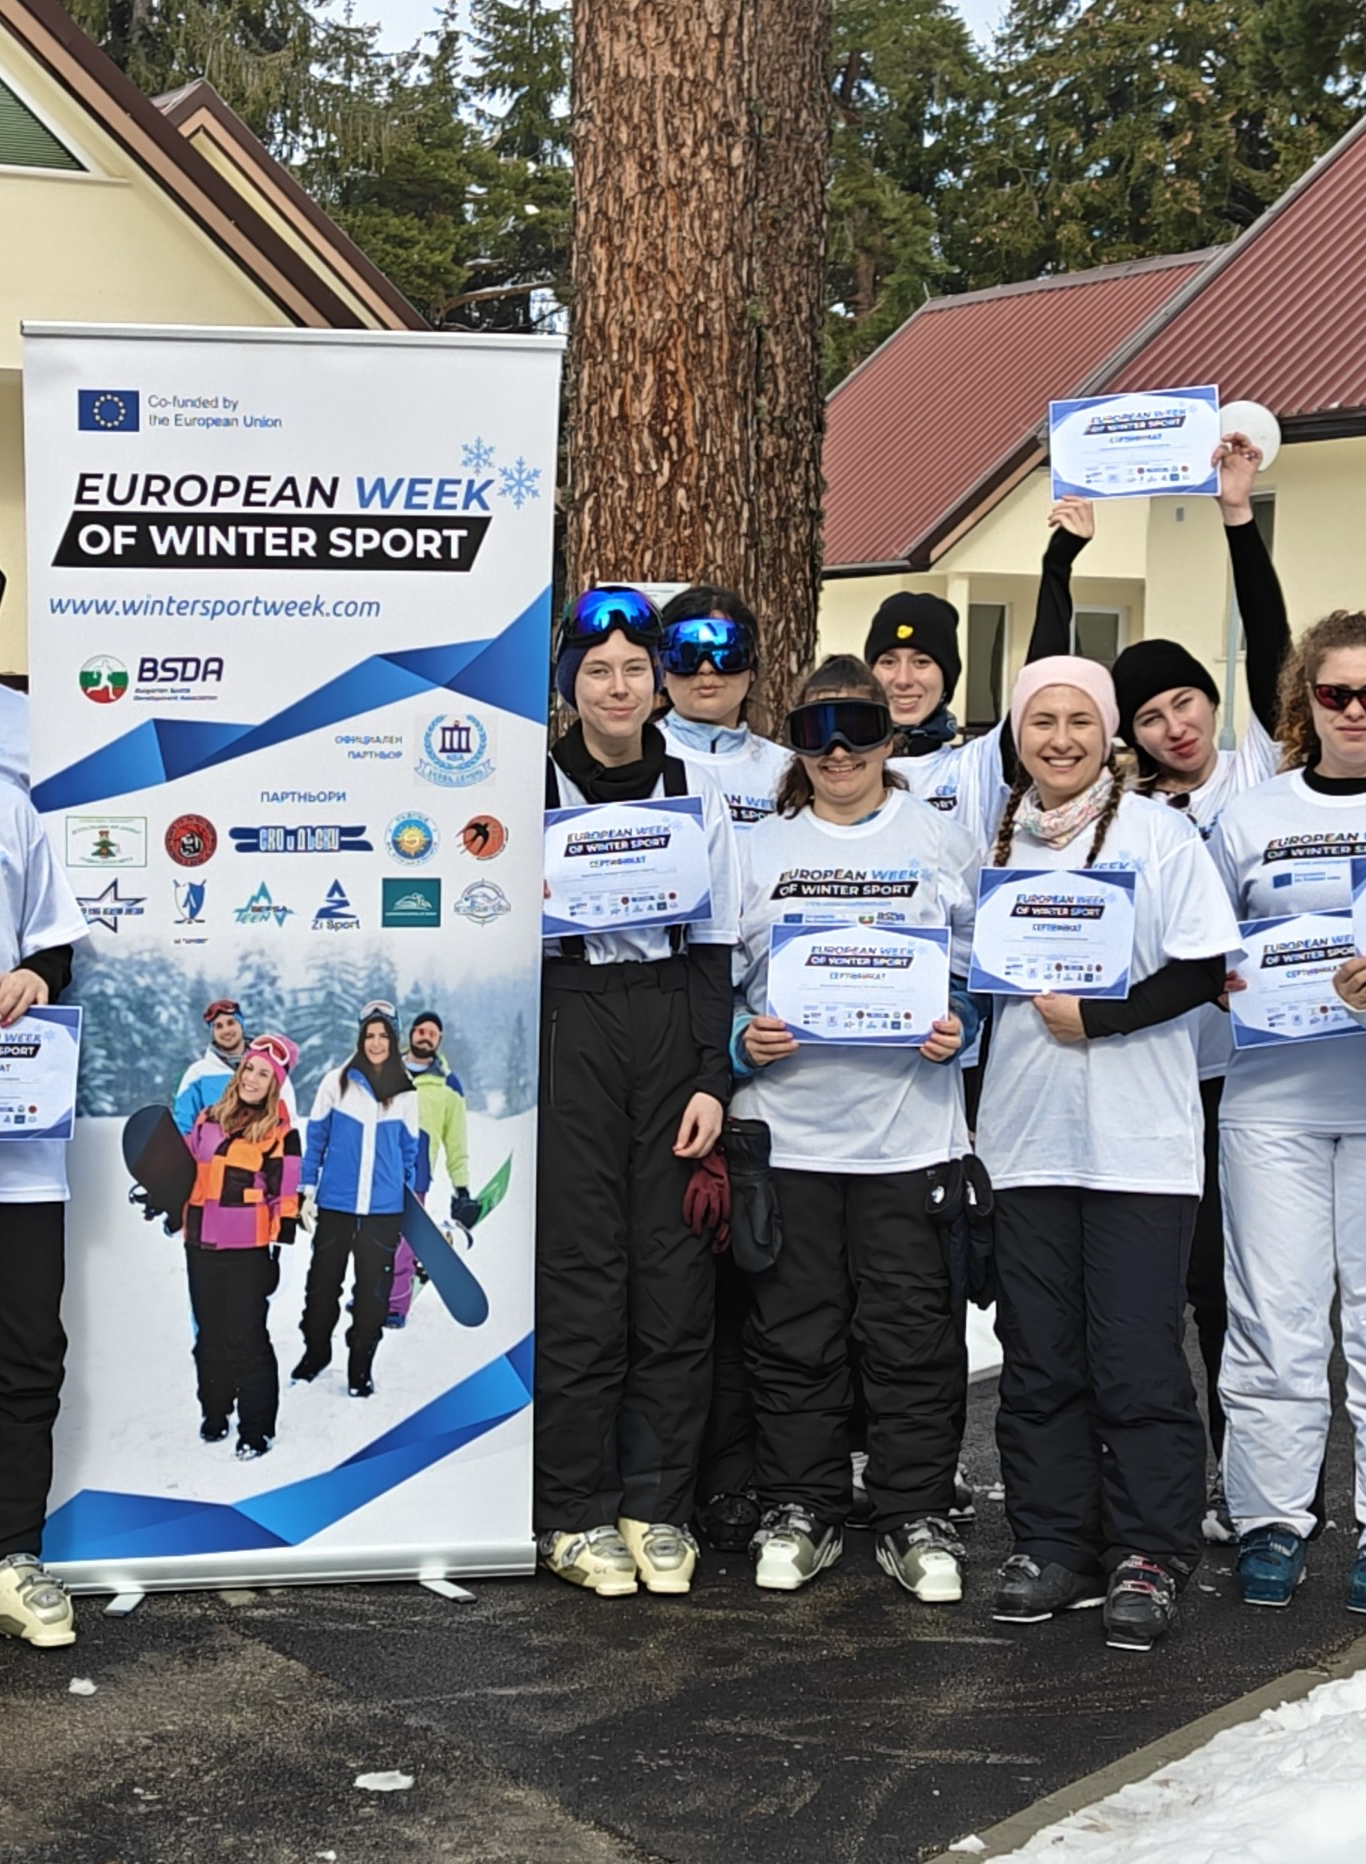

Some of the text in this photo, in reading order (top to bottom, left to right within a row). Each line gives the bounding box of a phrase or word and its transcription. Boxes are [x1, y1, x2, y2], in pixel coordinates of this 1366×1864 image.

[148, 395, 238, 412] Co-funded by
[148, 414, 282, 430] the European Union
[74, 473, 494, 511] EUROPEAN WEEK
[78, 524, 468, 559] OF WINTER SPORT
[49, 595, 380, 622] www.wintersportweek.com
[137, 657, 224, 682] BSDA
[261, 791, 347, 803] ПАРТНЬОРИ
[745, 797, 775, 808] WEE
[741, 810, 774, 821] SPO
[1268, 832, 1359, 849] EUROPEAN
[1267, 849, 1287, 860] OF
[1291, 845, 1352, 856] WINTER
[779, 868, 919, 882] EUROPEAN WEEK
[779, 883, 911, 896] OF WINTER SPORT
[326, 920, 360, 931] Sport
[811, 945, 915, 955] EUROPEAN WEEK
[1263, 938, 1328, 953] EUROPEAN
[811, 957, 909, 967] OF WINTER SPORT
[1266, 955, 1281, 965] OF
[1283, 949, 1327, 962] WINTER
[5, 1033, 41, 1043] WEEK
